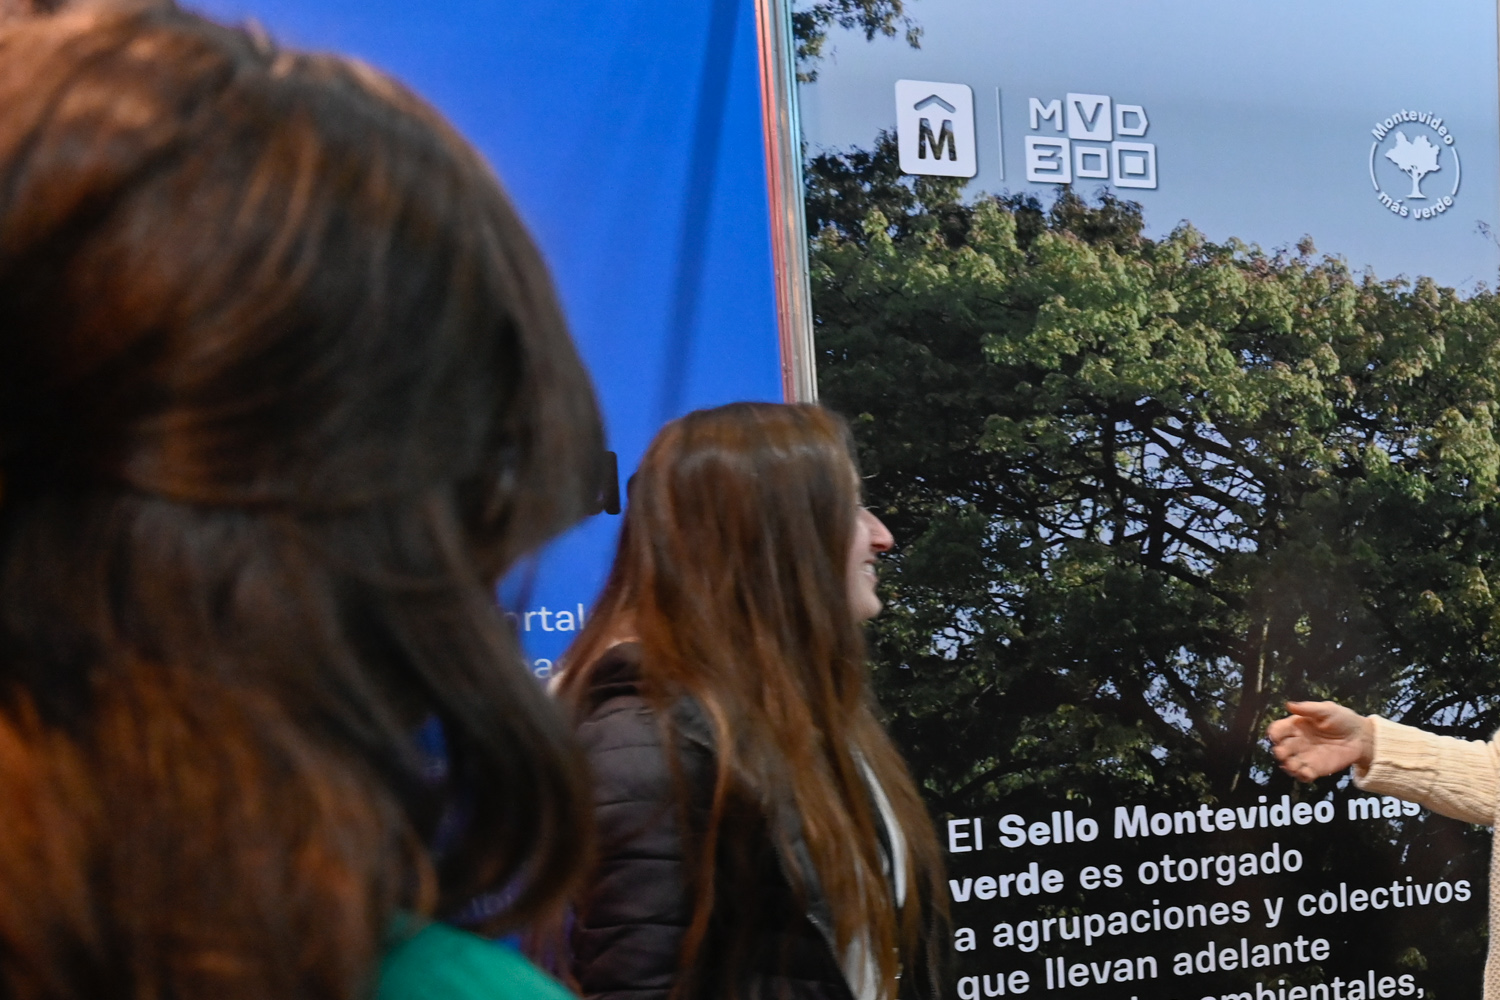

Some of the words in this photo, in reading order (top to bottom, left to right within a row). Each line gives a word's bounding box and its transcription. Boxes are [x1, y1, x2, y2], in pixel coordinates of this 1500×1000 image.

[1029, 95, 1149, 139] MVD
[1371, 108, 1455, 146] Montevideo
[1378, 191, 1410, 218] más
[1413, 195, 1454, 220] verde
[948, 818, 982, 852] El
[999, 811, 1098, 847] Sello
[1115, 795, 1334, 838] Montevideo
[949, 862, 1063, 902] verde
[1080, 865, 1122, 889] es
[1139, 843, 1302, 885] otorgado
[955, 928, 975, 951] a
[993, 899, 1250, 952] agrupaciones
[1264, 897, 1283, 928] y
[1298, 876, 1471, 916] colectivos
[1046, 956, 1157, 989] llevan
[1174, 935, 1329, 975] adelante
